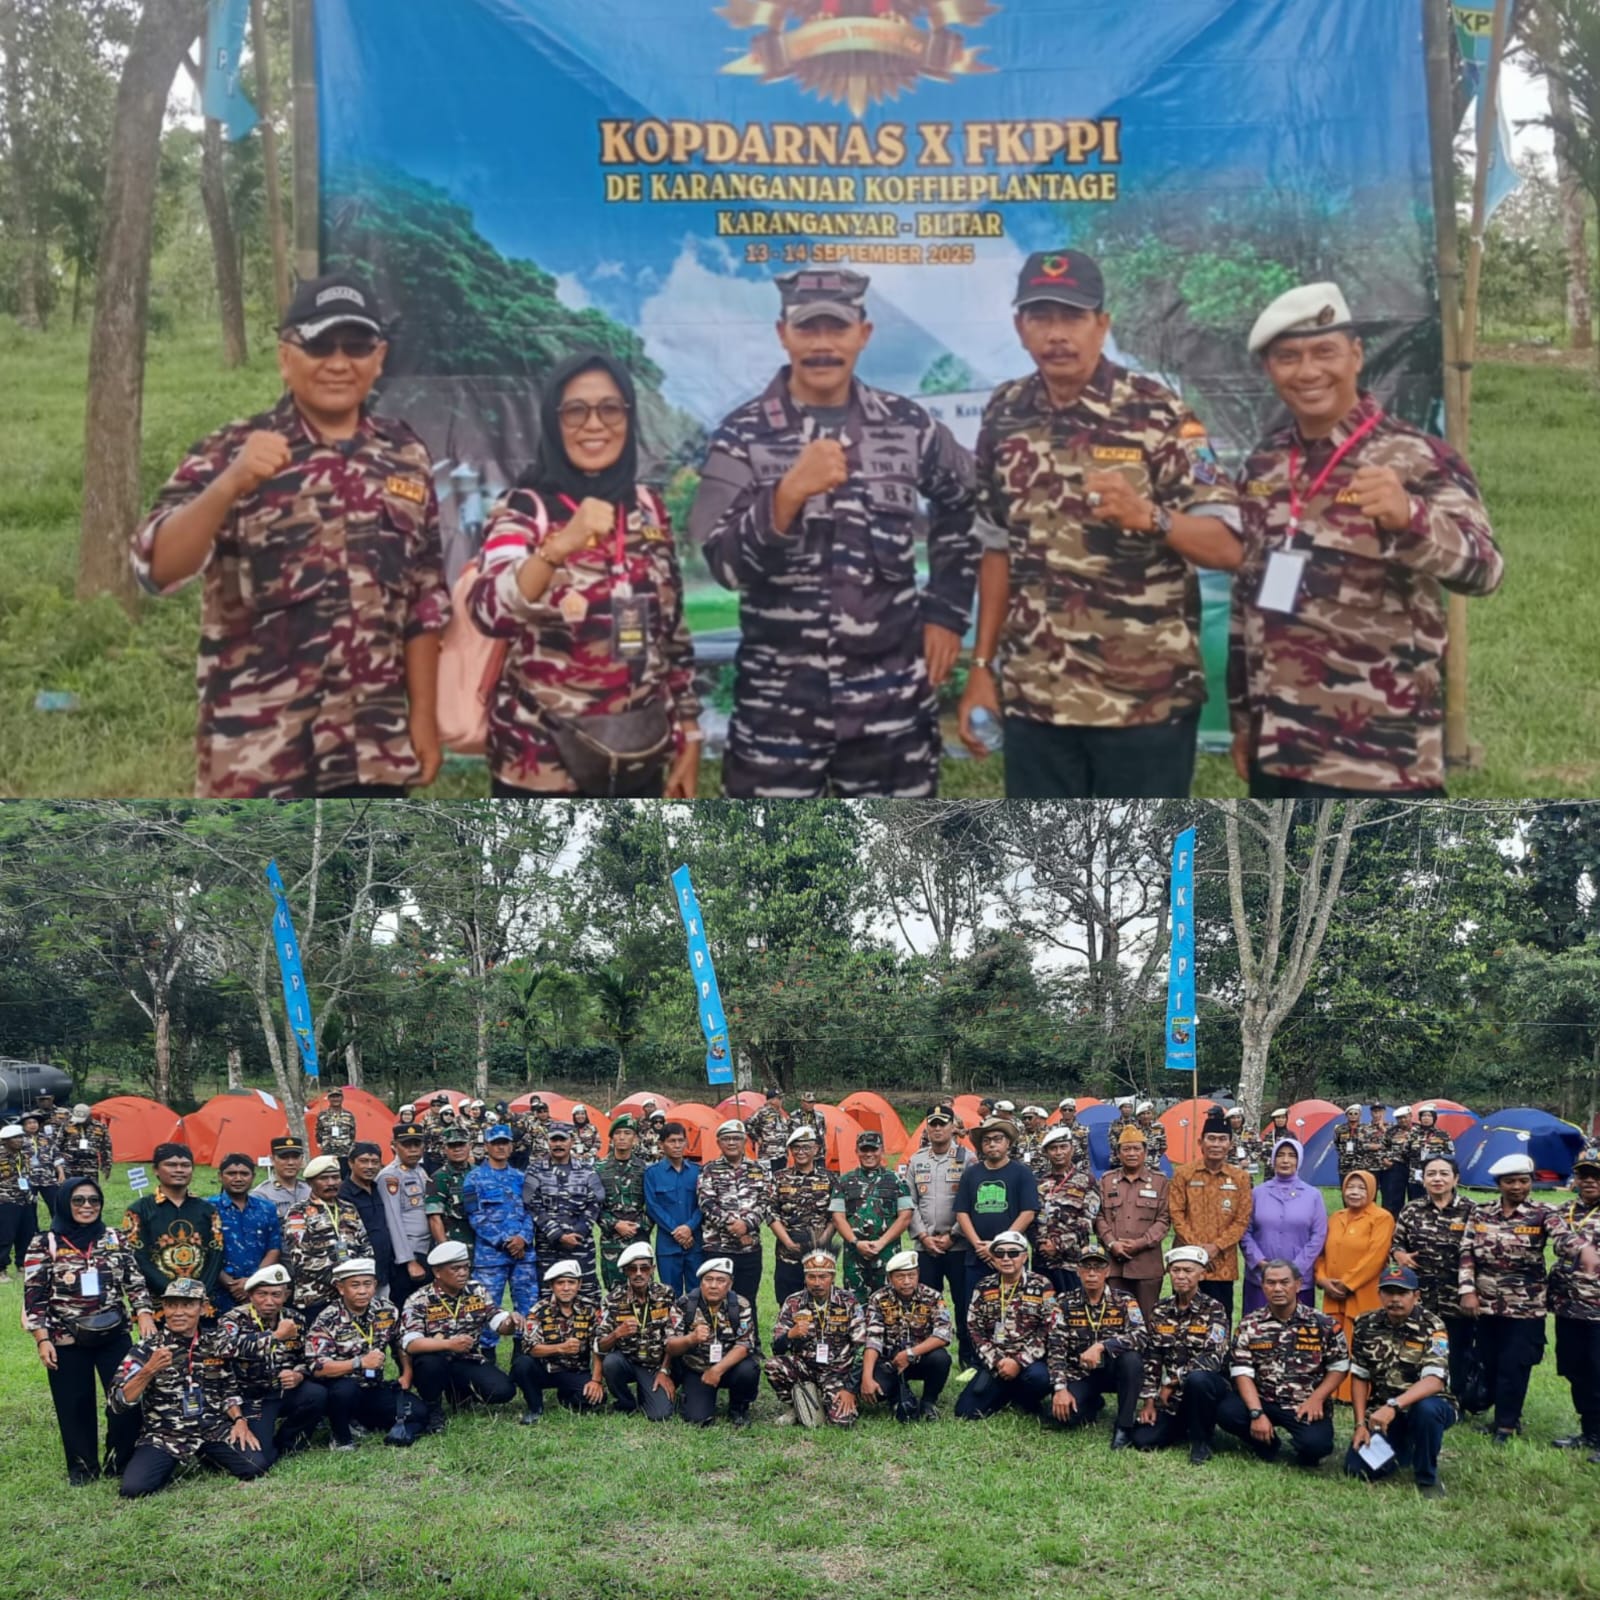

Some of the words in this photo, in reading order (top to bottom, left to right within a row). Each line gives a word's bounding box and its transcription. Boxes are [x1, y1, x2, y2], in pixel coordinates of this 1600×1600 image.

[599, 119, 905, 167] KOPDARNAS
[917, 122, 953, 166] X
[964, 119, 1120, 166] FKPPI
[605, 173, 641, 202] DE
[650, 172, 856, 202] KARANGANJAR
[863, 172, 1117, 203] KOFFIEPLANTAGE
[717, 210, 897, 236] KARANGANYAR
[916, 211, 1002, 236] BLITAR
[746, 243, 769, 262] 13
[784, 243, 807, 262] 14
[812, 243, 922, 263] SEPTEMBER
[928, 244, 974, 264] 2025
